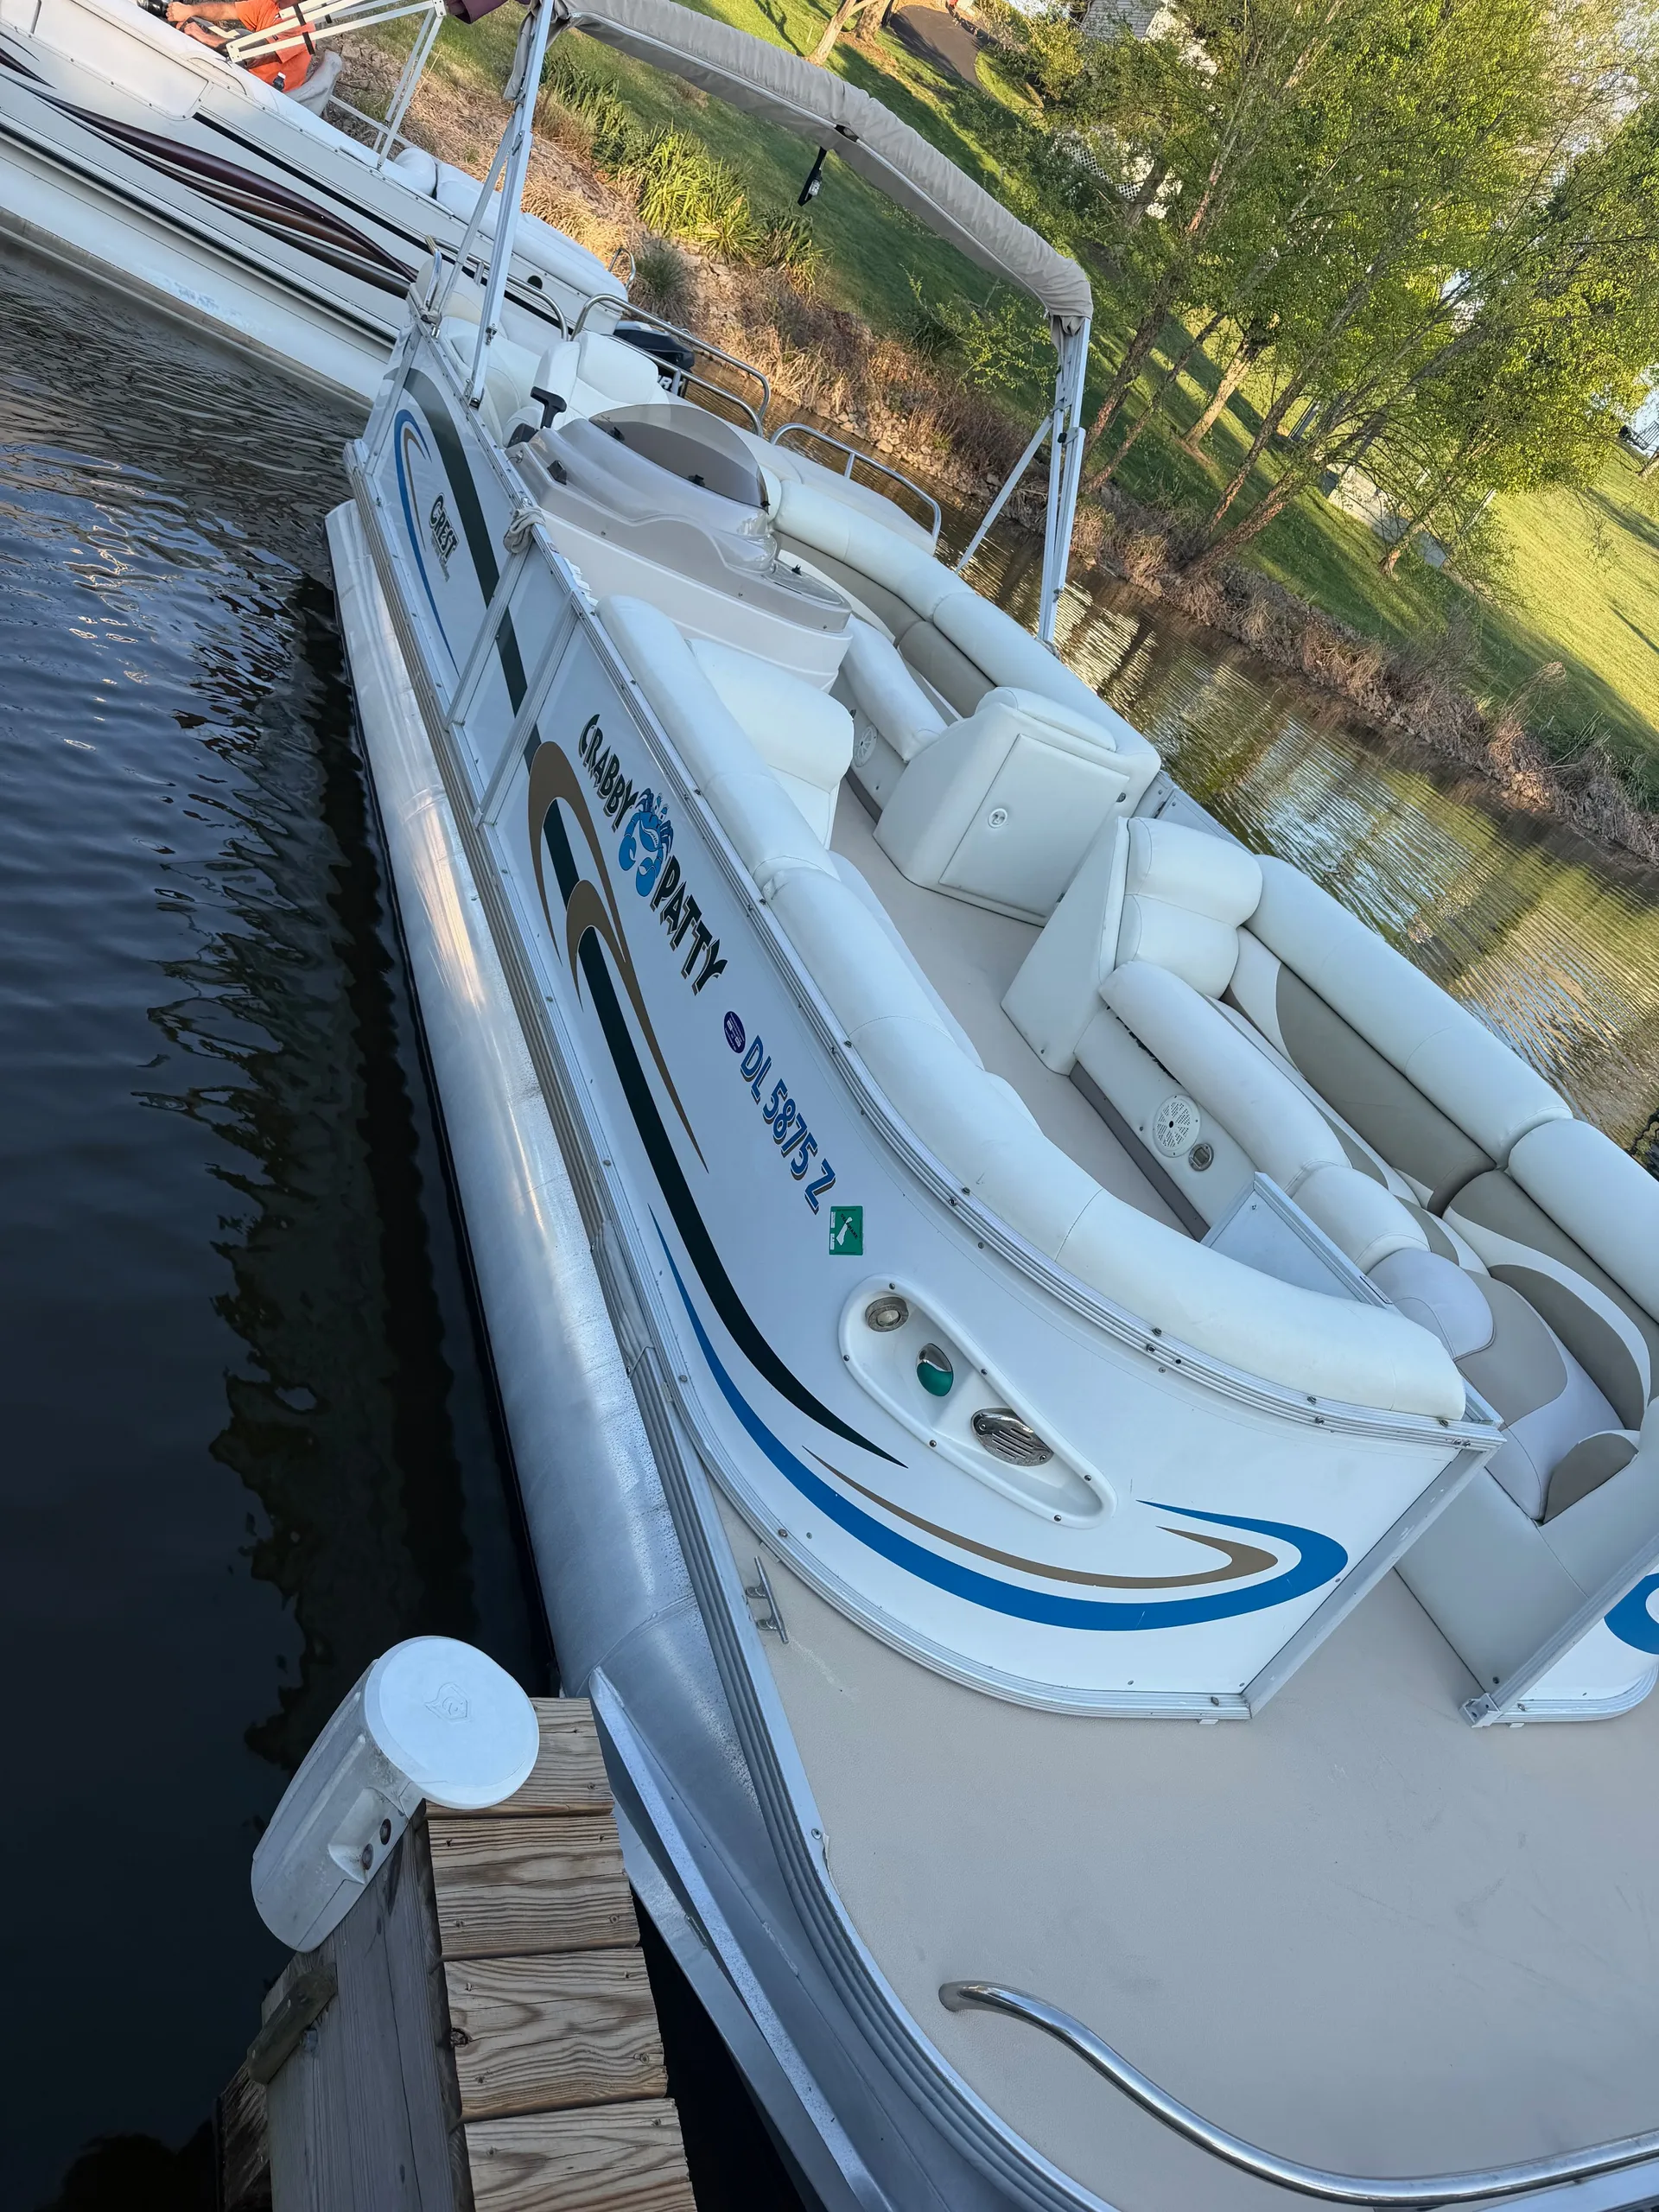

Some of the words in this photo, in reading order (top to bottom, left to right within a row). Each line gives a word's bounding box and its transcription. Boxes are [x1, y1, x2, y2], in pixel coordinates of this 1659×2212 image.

[429, 492, 459, 565] CREST
[578, 714, 639, 833] CRABBY
[650, 855, 728, 996] PATTY
[741, 1034, 772, 1105] DL
[762, 1078, 818, 1180] 5875
[804, 1158, 836, 1215] Z
